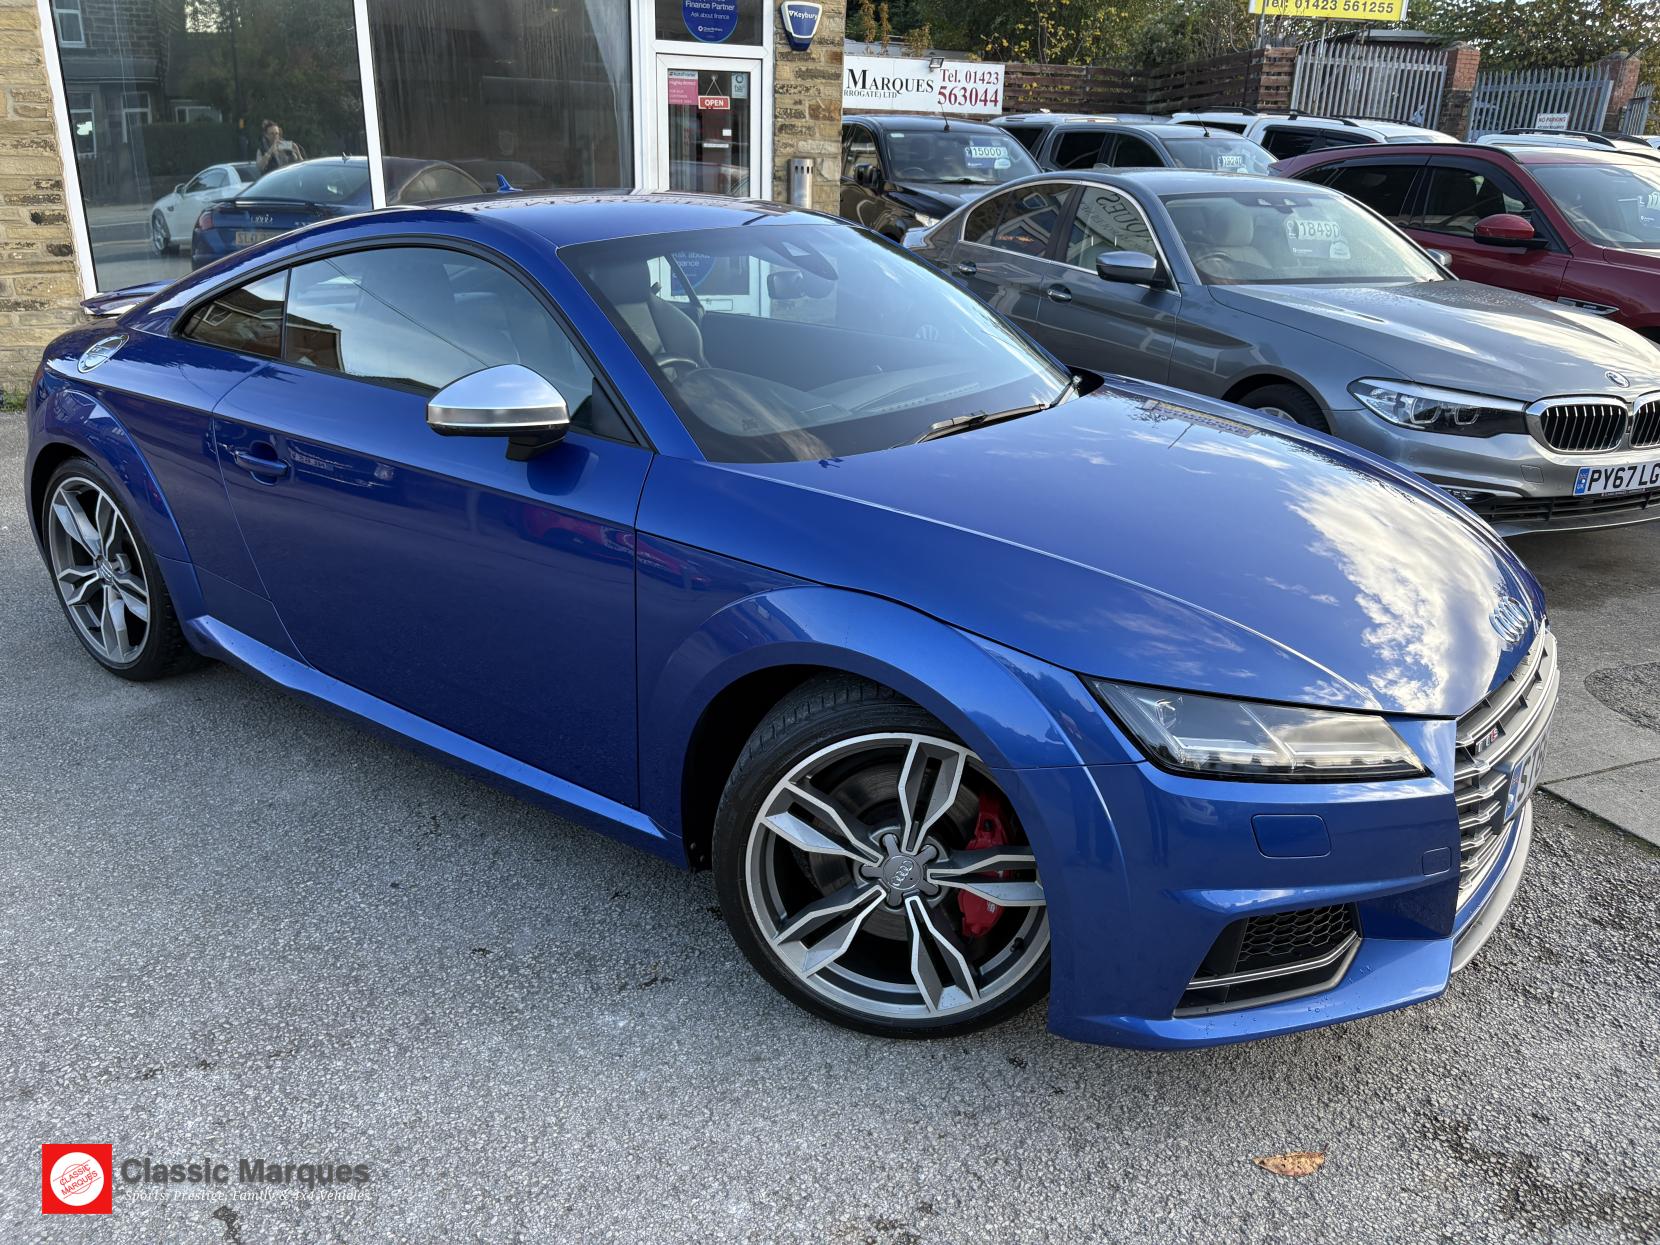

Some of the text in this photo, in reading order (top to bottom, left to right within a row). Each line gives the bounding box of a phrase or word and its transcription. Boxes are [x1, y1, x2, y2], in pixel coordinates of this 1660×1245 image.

[685, 1, 711, 9] Finance
[1295, 0, 1338, 10] 01423
[1343, 1, 1394, 13] 561255
[847, 68, 934, 94] MARQUES
[940, 69, 999, 85] Tel. 01423
[704, 99, 724, 107] OPEN
[937, 86, 999, 107] 563044
[1587, 465, 1638, 492] PY67
